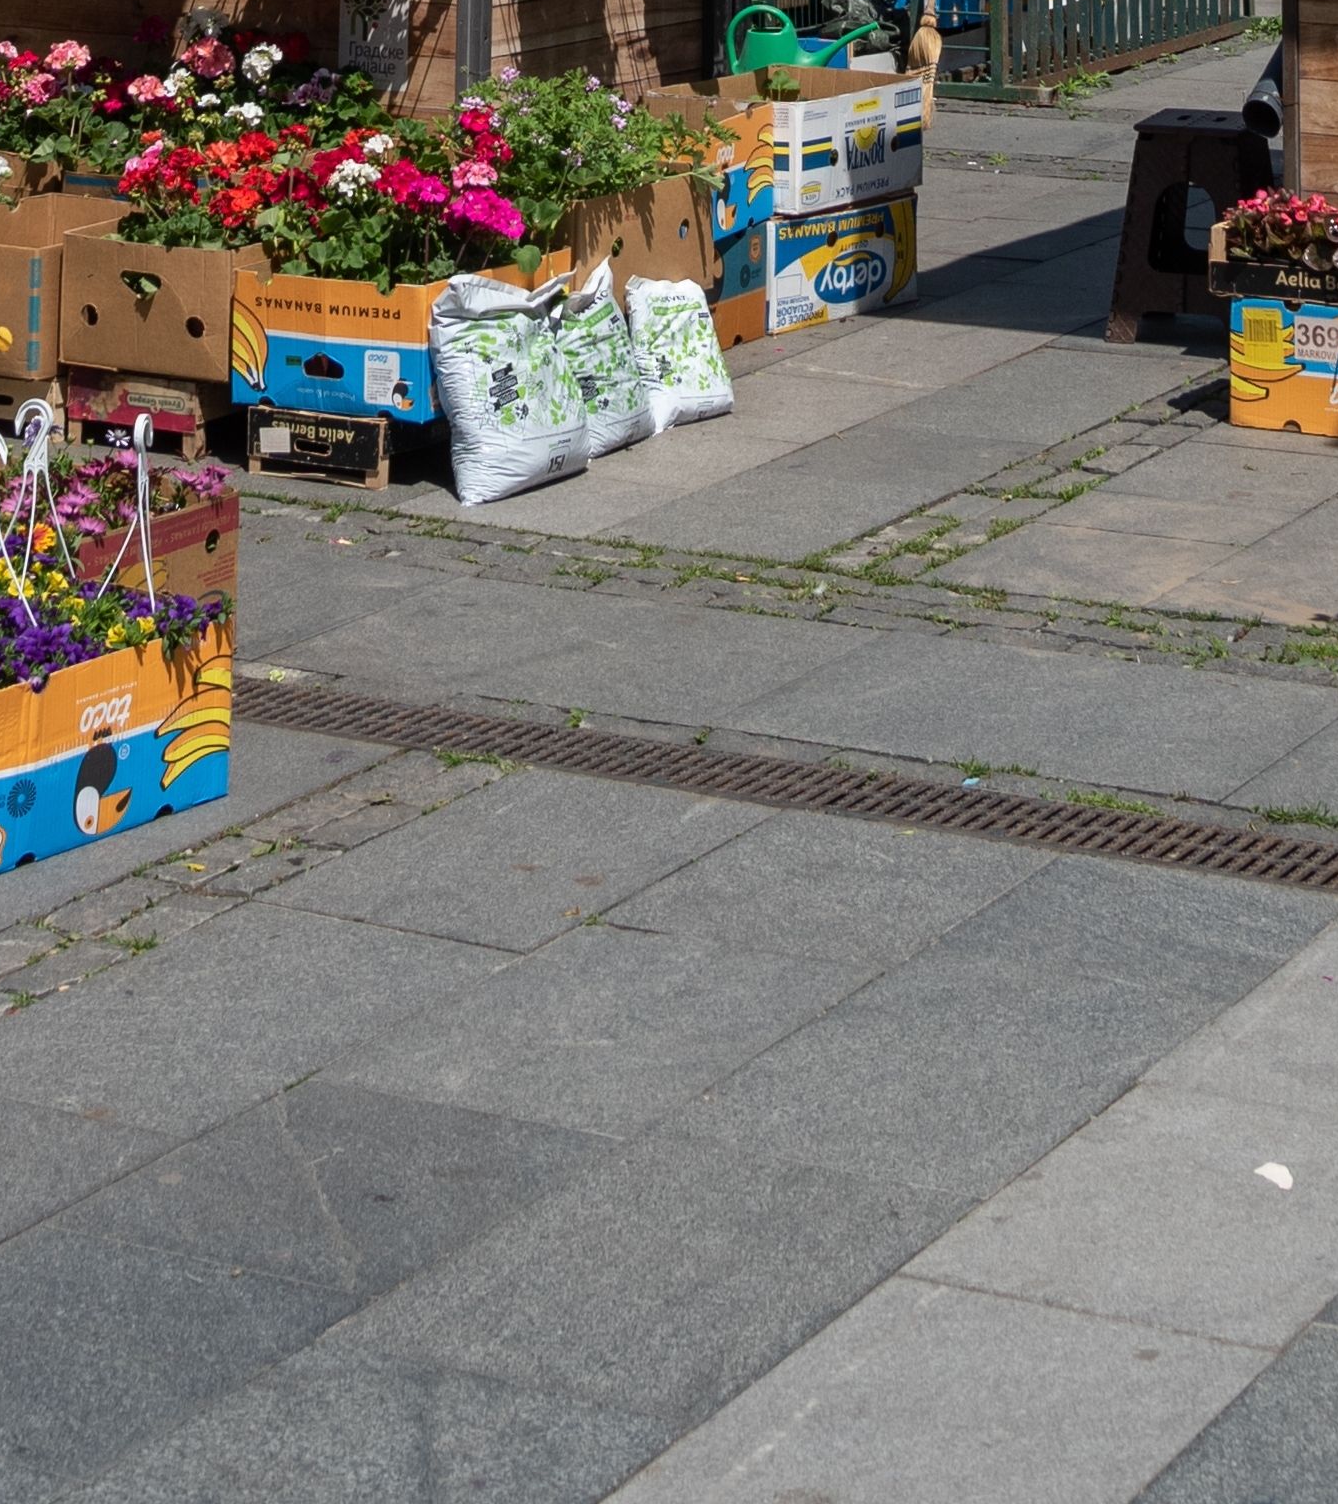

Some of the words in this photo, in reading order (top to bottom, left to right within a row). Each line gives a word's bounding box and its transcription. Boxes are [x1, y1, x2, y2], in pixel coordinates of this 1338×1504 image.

[349, 41, 405, 61] Градске
[844, 127, 886, 171] BONITA
[835, 185, 854, 198] PACK
[855, 176, 890, 192] PREMIUM
[838, 211, 884, 231] PREMIUM
[779, 221, 836, 240] BANANAS
[819, 259, 882, 296] derby
[1275, 270, 1321, 289] Aelia
[254, 296, 322, 313] BANANAS
[329, 304, 401, 320] PREMIUM
[775, 302, 814, 318] ECUADOR
[775, 316, 787, 328] OF
[788, 309, 824, 324] PRODUCE
[1297, 348, 1337, 361] MARKOVA
[129, 395, 156, 407] Grapes
[158, 400, 181, 409] Fresh
[318, 427, 355, 444] Aelia
[79, 693, 133, 733] toco
